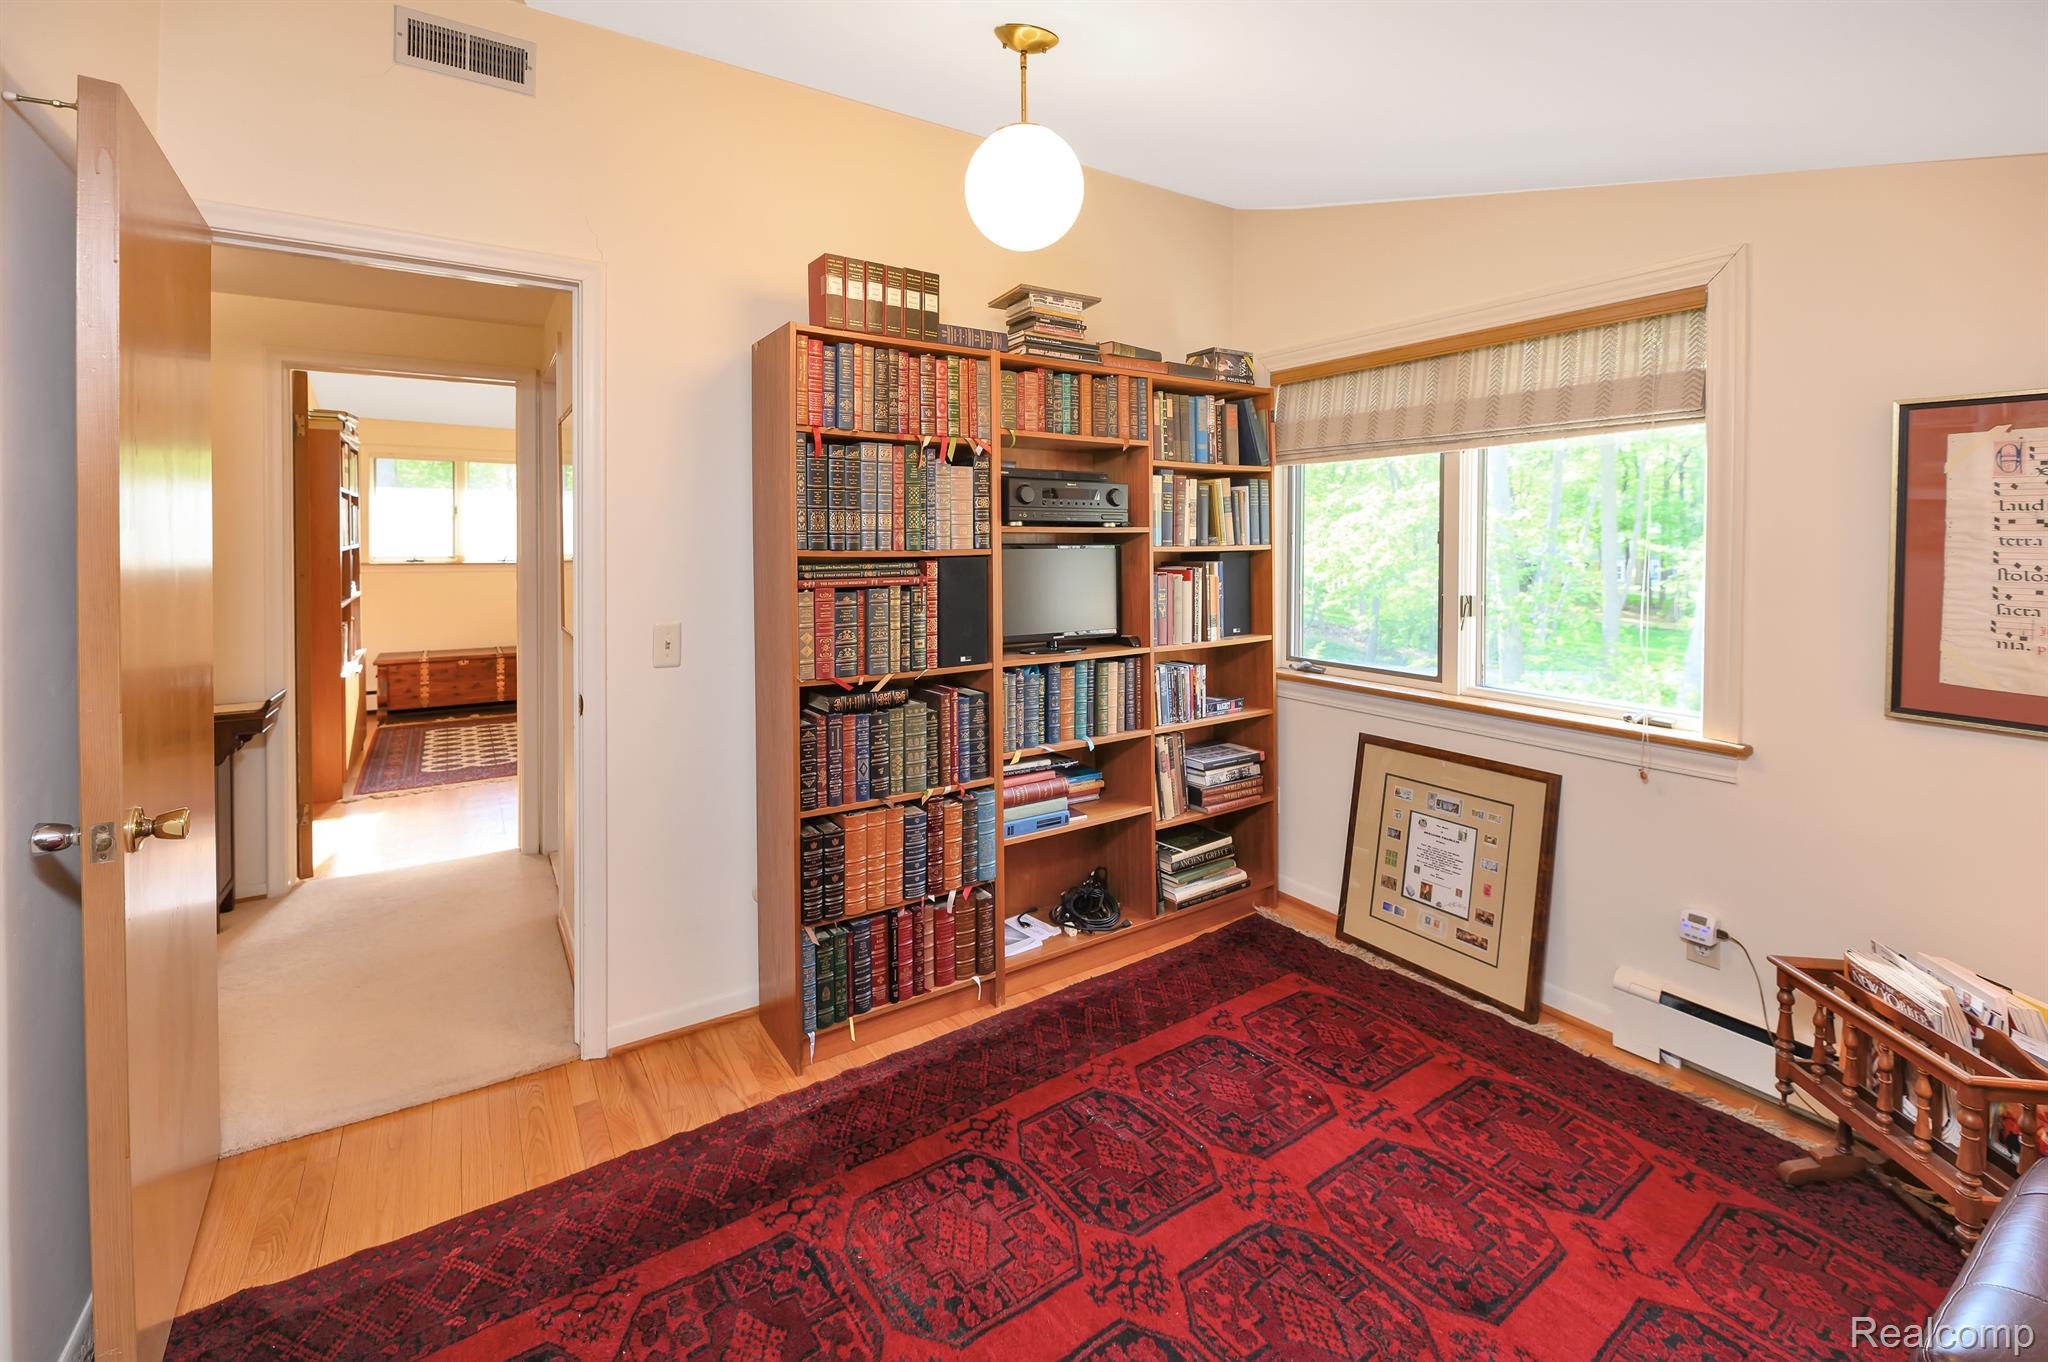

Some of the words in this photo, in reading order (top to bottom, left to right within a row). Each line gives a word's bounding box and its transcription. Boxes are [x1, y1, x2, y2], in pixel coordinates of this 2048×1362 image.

[1180, 855, 1205, 868] ANCIENT
[1205, 847, 1229, 860] GREECE
[1851, 969, 1879, 994] NEW
[1880, 987, 1928, 1026] YORKER
